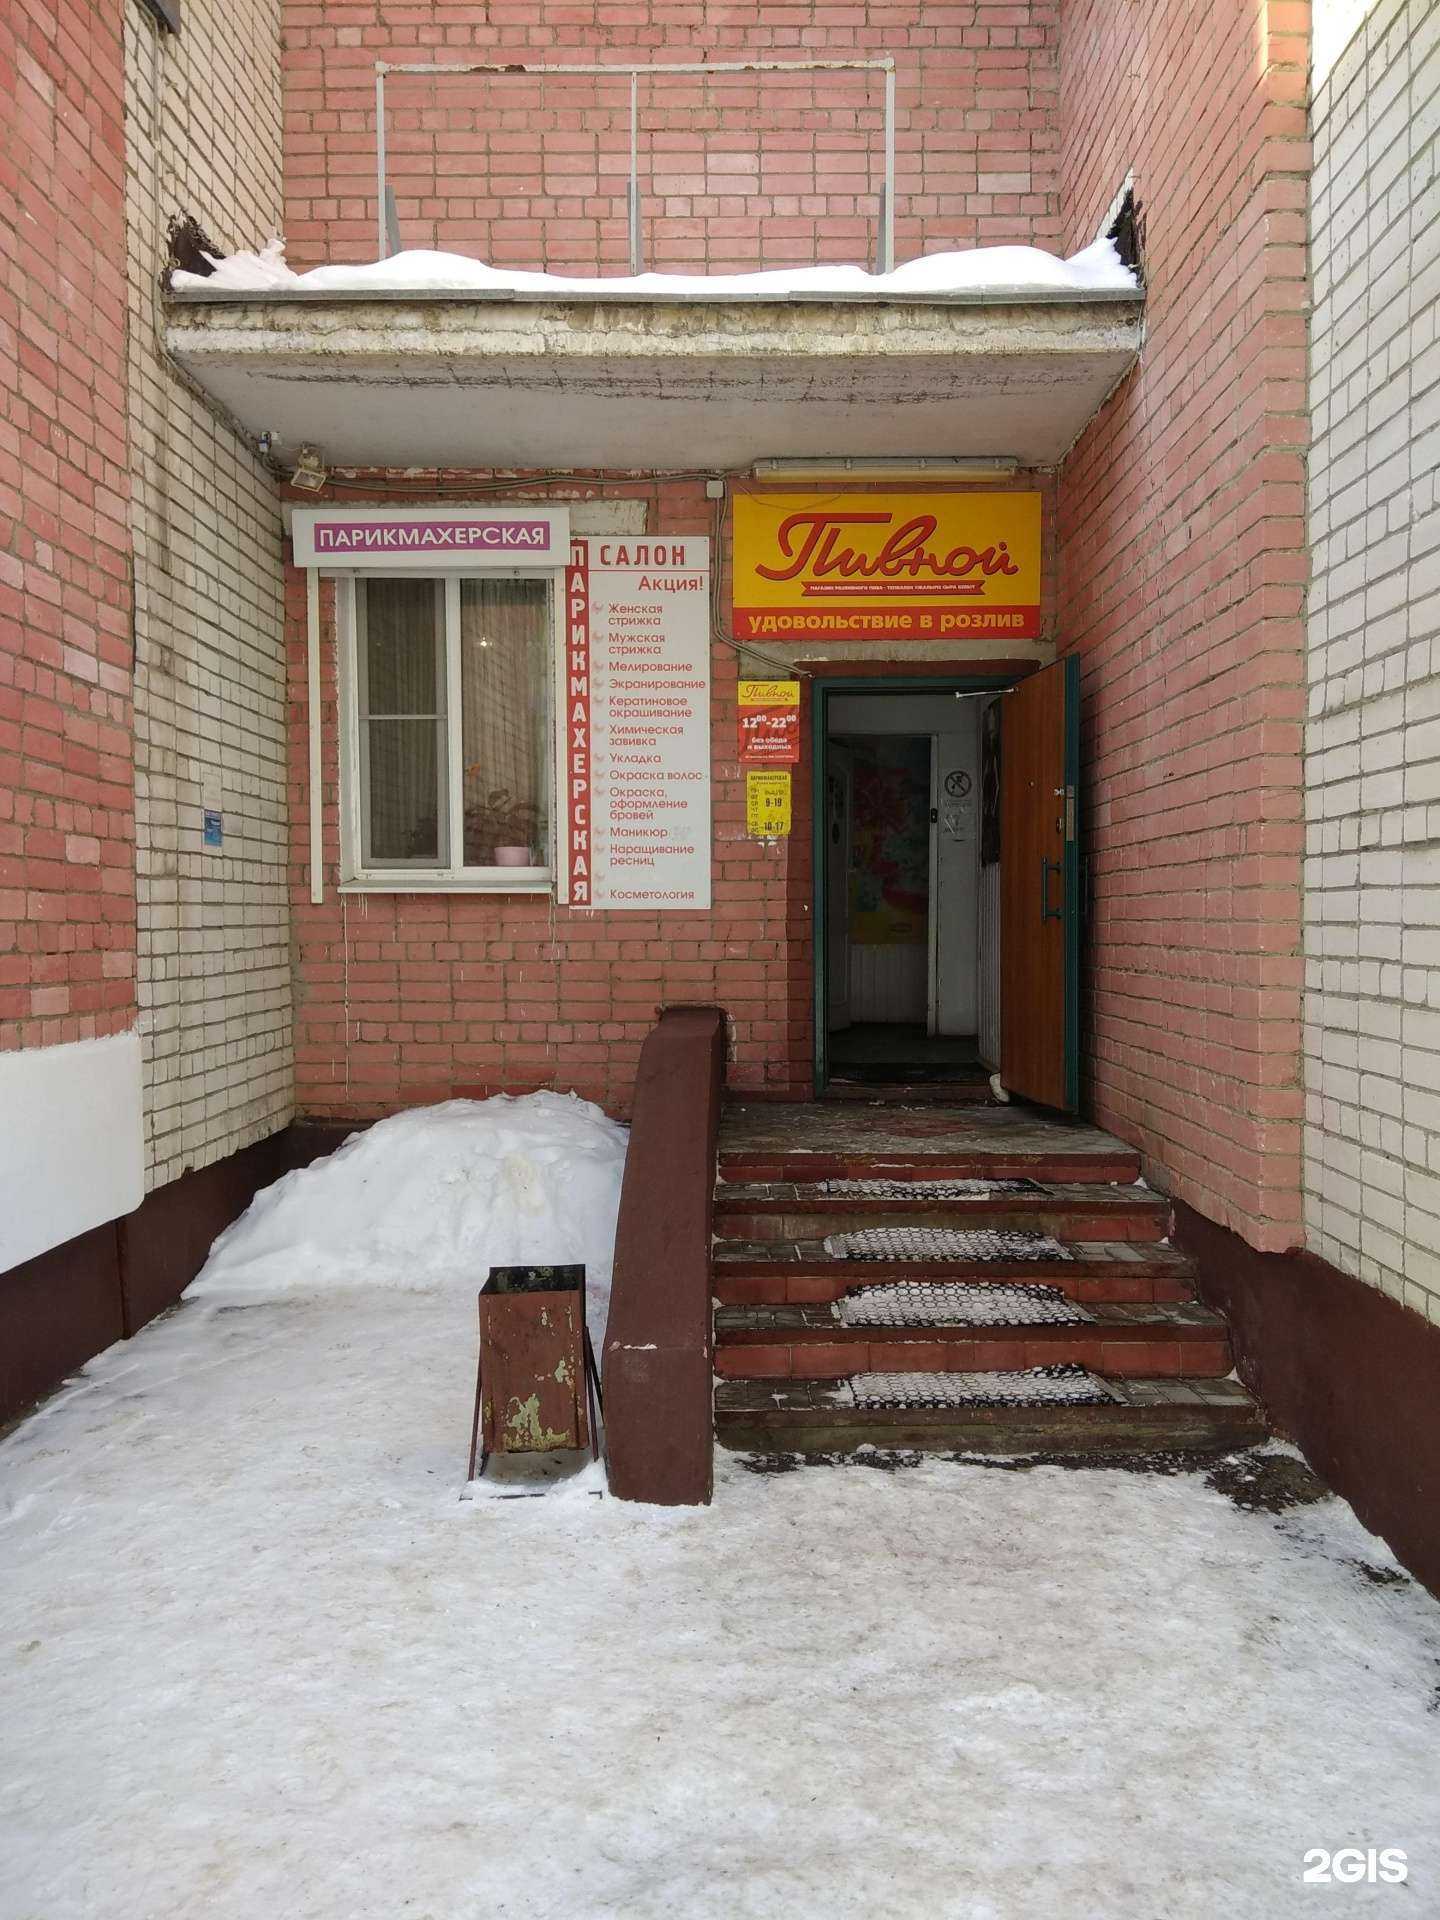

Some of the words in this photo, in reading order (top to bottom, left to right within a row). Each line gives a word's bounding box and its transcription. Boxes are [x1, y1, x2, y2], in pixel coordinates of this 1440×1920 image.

[319, 527, 544, 547] ПАРИКМАХЕРСКАЯ
[755, 512, 1020, 581] Пивной
[600, 545, 685, 566] САЛОН
[638, 576, 703, 593] Акция!
[608, 604, 662, 614] Женская
[608, 617, 661, 627] стрижка
[748, 615, 913, 633] удовольствие
[920, 617, 932, 628] в
[941, 614, 1025, 632] розлив
[608, 634, 665, 644] Мужская
[608, 646, 661, 656] стрижка
[609, 662, 692, 673] Мелирование
[609, 679, 705, 690] Экранирование
[609, 696, 688, 707] Кератиновое
[609, 708, 692, 718] окрашивание
[571, 546, 588, 901] ПАРИКМАХЕРСКАЯ
[609, 725, 683, 735] Химическая
[609, 737, 656, 746] завивка
[609, 753, 661, 764] Укладка
[610, 771, 664, 782] Окраска
[667, 771, 702, 780] волос
[610, 787, 667, 799] Окраска,
[610, 799, 688, 810] оформление
[610, 810, 653, 821] бровей
[610, 828, 667, 838] Маникюр
[610, 845, 694, 855] Наращивание
[610, 856, 654, 866] ресниц
[610, 889, 694, 899] Косметология
